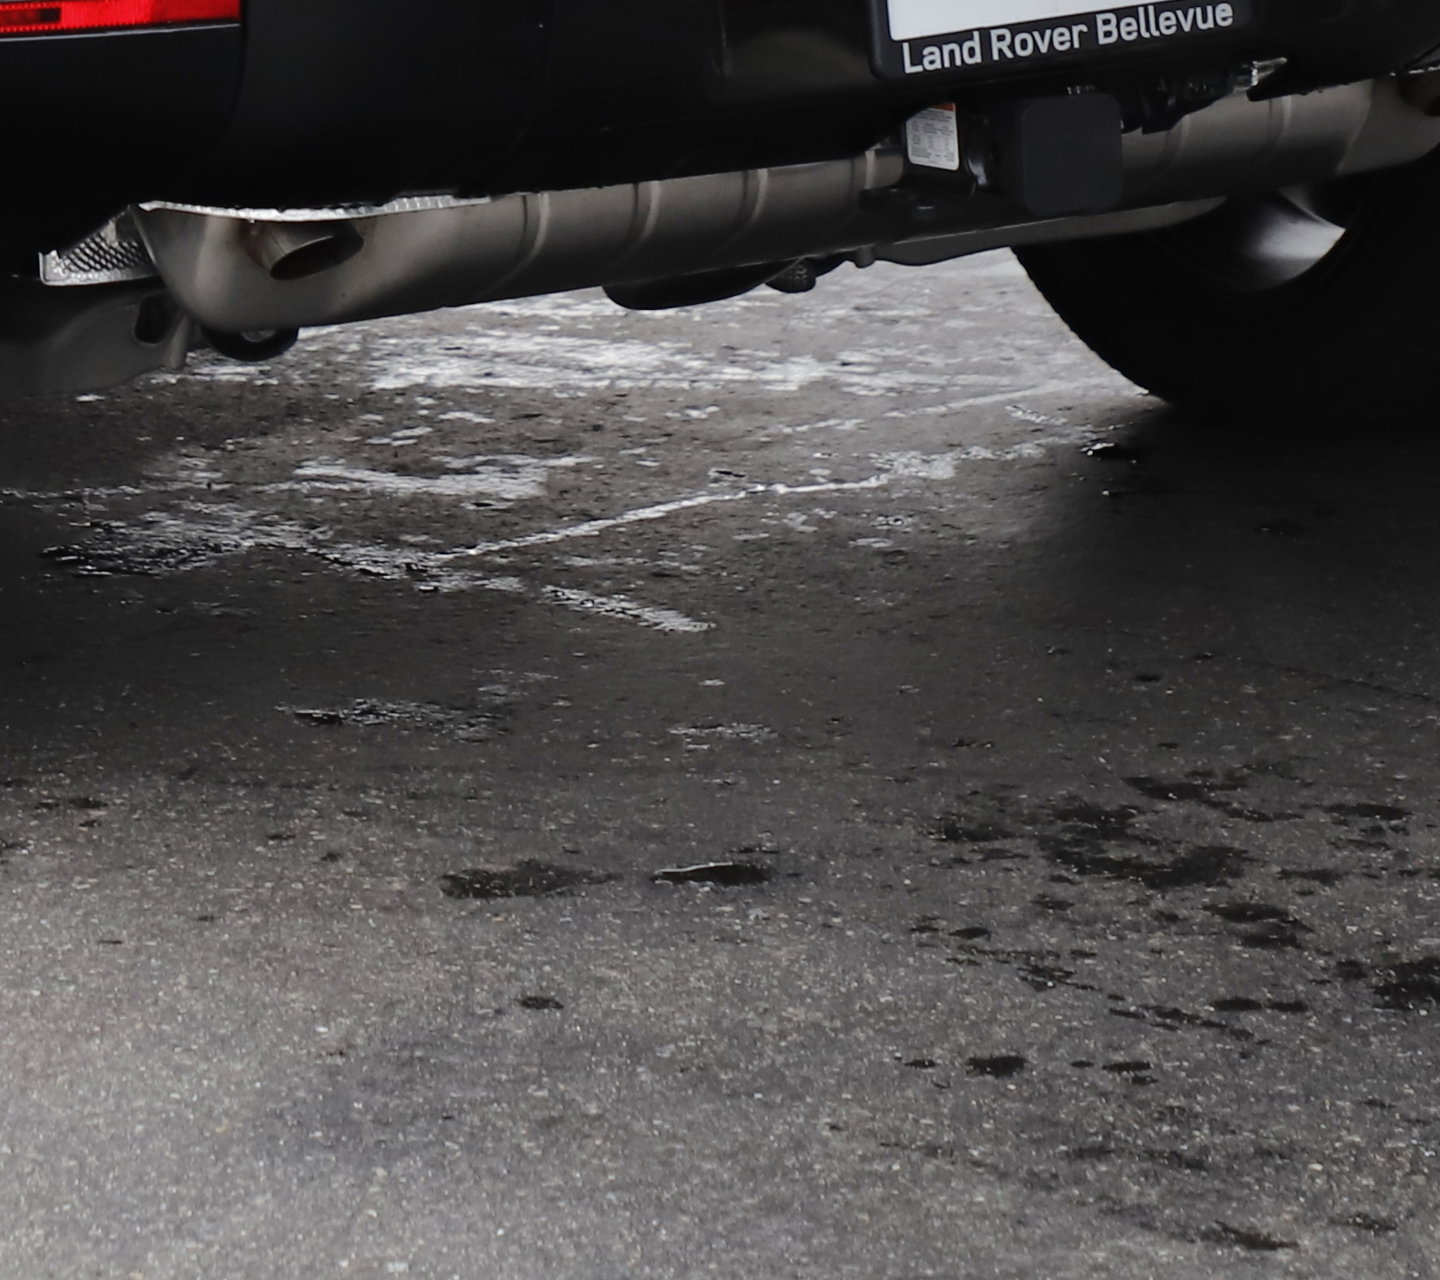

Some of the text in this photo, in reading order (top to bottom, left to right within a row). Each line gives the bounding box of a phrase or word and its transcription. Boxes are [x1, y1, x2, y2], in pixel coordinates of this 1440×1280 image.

[901, 1, 1234, 75] Land Rover Bellevue
